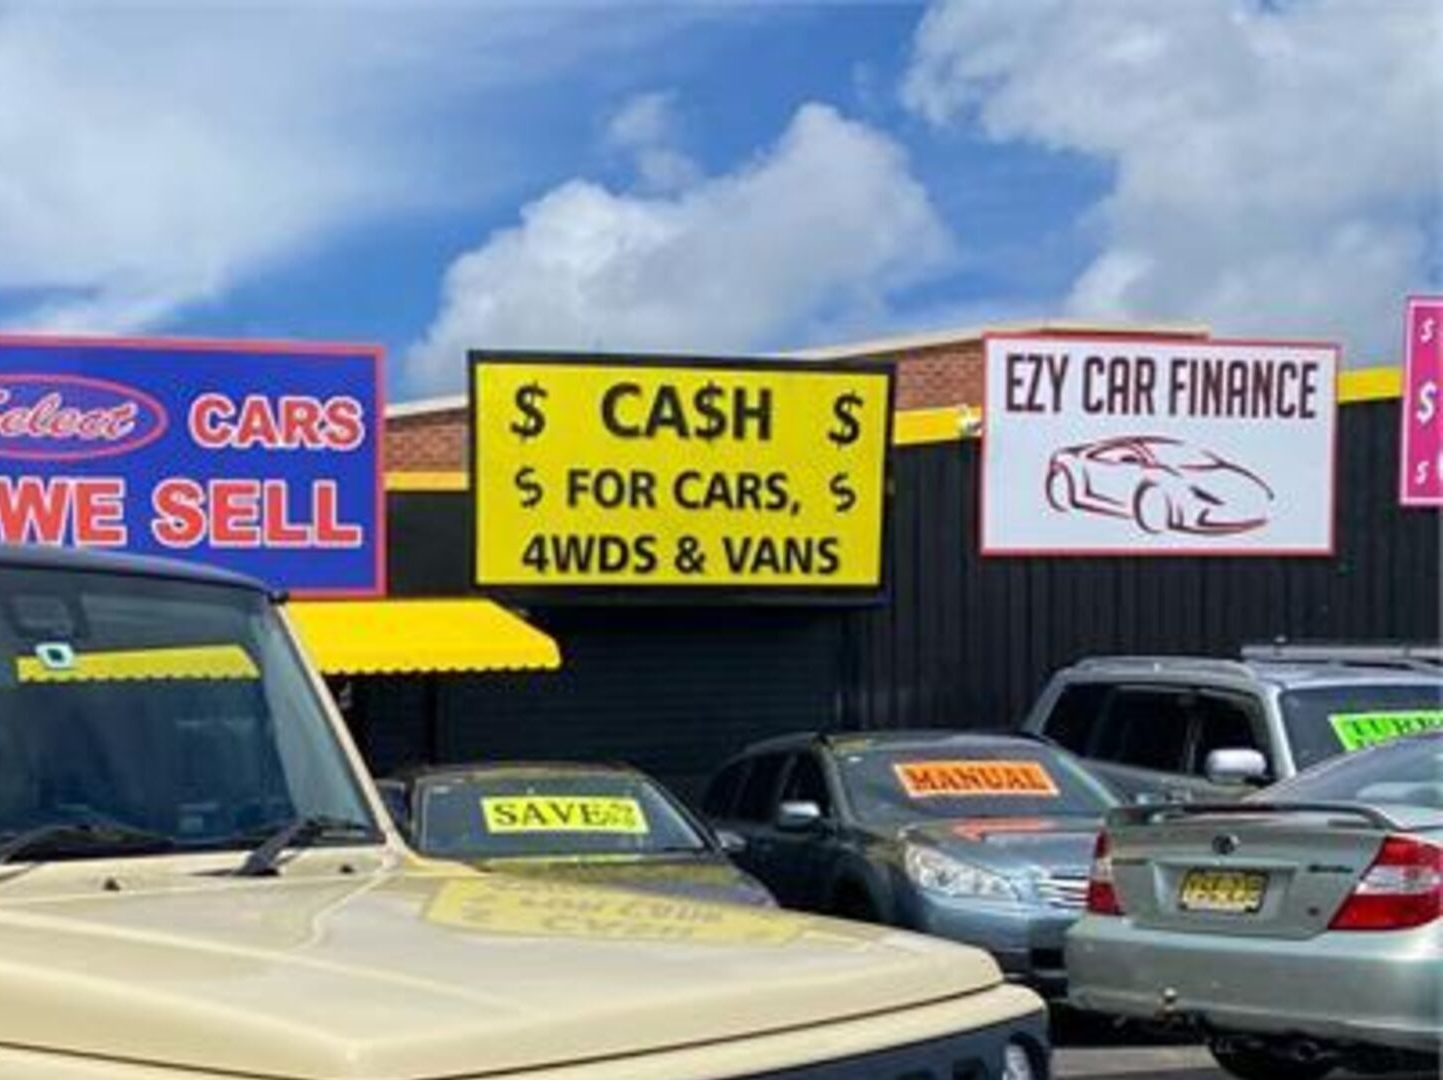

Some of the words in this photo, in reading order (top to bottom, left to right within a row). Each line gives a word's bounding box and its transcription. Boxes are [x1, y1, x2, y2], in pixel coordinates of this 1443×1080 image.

[1006, 354, 1069, 414] EZY
[1081, 356, 1156, 416] CAR
[1167, 358, 1318, 419] FINANCE
[189, 393, 365, 451] CARS
[152, 478, 362, 547] SELL
[566, 469, 656, 508] FOR
[673, 470, 800, 516] CARS,
[522, 534, 658, 575] 4WDS
[674, 535, 706, 575] &
[722, 536, 840, 576] VANS
[904, 765, 1050, 791] MANUAL
